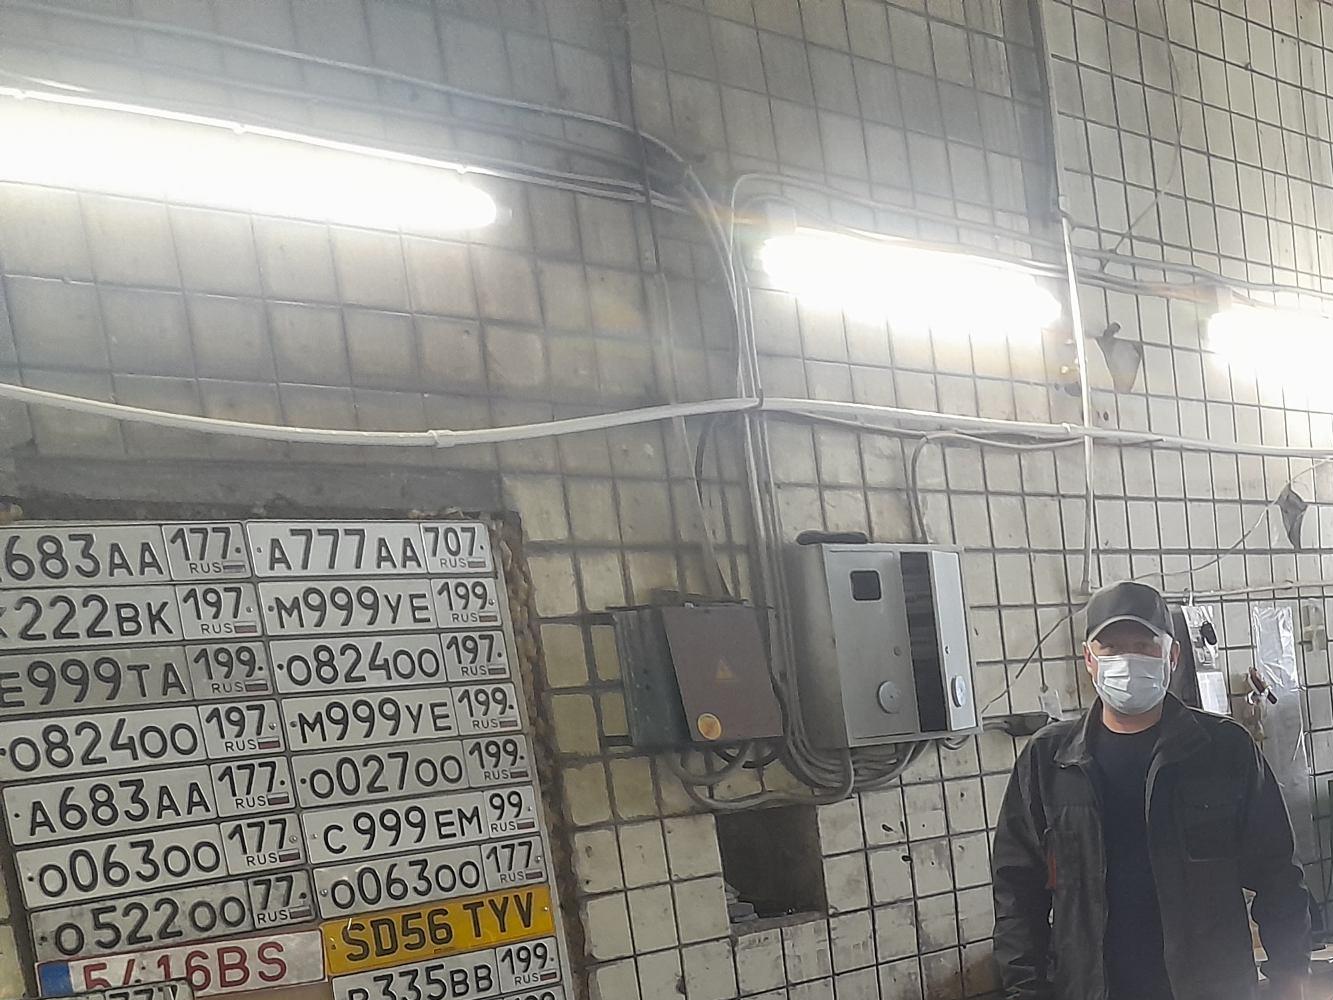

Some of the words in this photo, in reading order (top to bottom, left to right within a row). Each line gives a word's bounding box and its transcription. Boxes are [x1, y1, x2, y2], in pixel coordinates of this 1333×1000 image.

[170, 526, 232, 562] 177
[424, 526, 476, 557] 707
[189, 562, 222, 574] RUS
[440, 557, 467, 569] RUS
[182, 586, 242, 621] 197
[437, 581, 488, 611] 199
[200, 622, 233, 635] RUS
[451, 611, 478, 623] RUS
[193, 645, 257, 681] 199
[446, 633, 494, 665] 197
[461, 664, 488, 677] RUS
[211, 681, 245, 694] RUS
[457, 686, 508, 718] 199
[205, 703, 266, 740] 197
[472, 717, 499, 729] RUS
[224, 738, 258, 752] RUS
[468, 738, 518, 770] 199
[217, 760, 277, 798] 177
[484, 769, 510, 781] RUS
[235, 795, 267, 809] RUS
[488, 790, 523, 821] 99
[227, 817, 287, 855] 177
[490, 820, 517, 833] RUS
[246, 852, 278, 867] RUS
[486, 840, 533, 874] 177
[252, 875, 294, 910] 77
[499, 871, 525, 884] RUS
[256, 909, 289, 925] RUS
[341, 908, 453, 962] SD56
[462, 892, 534, 938] TYV
[500, 942, 548, 975] 199
[514, 973, 539, 986] RUS
